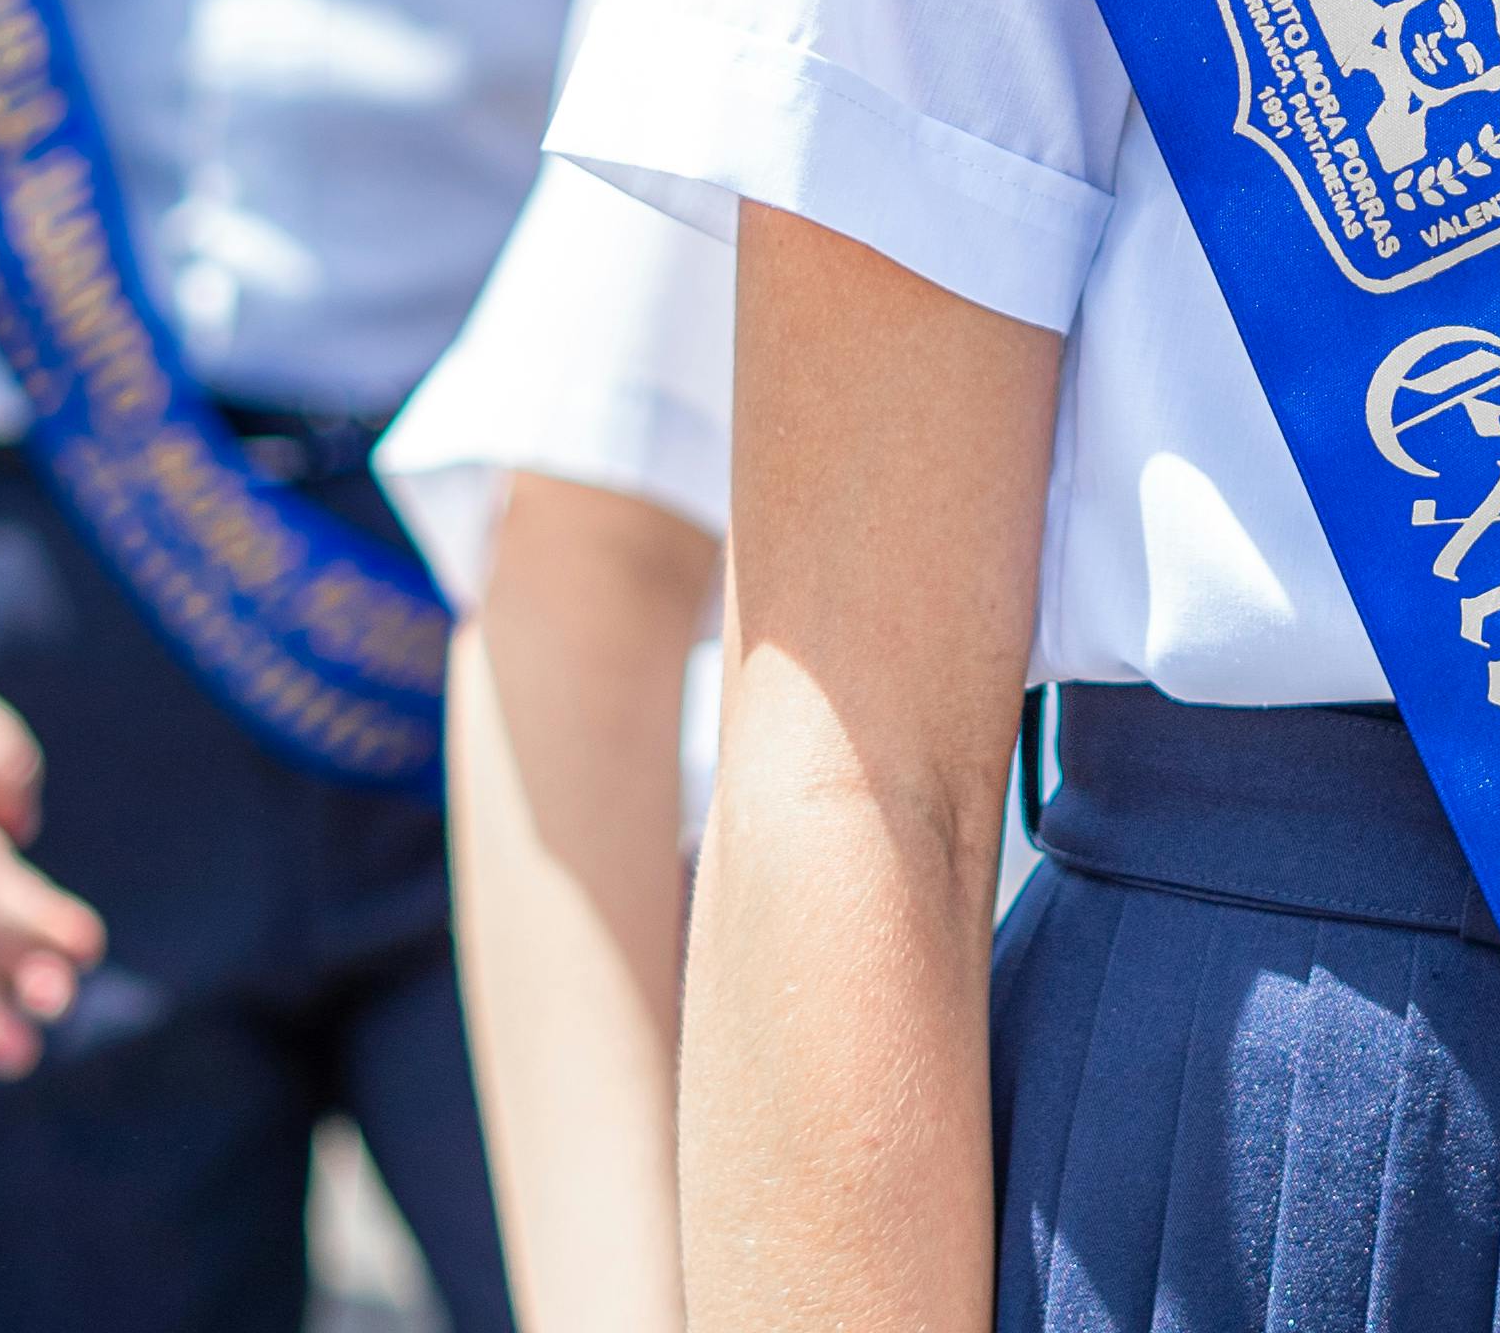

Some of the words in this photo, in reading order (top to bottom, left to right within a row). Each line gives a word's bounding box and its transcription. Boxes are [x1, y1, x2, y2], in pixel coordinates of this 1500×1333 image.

[1257, 85, 1293, 139] 1991
[1289, 93, 1364, 240] PUNTARENAS
[1294, 50, 1348, 140] MORA
[1334, 138, 1401, 259] PORRAS
